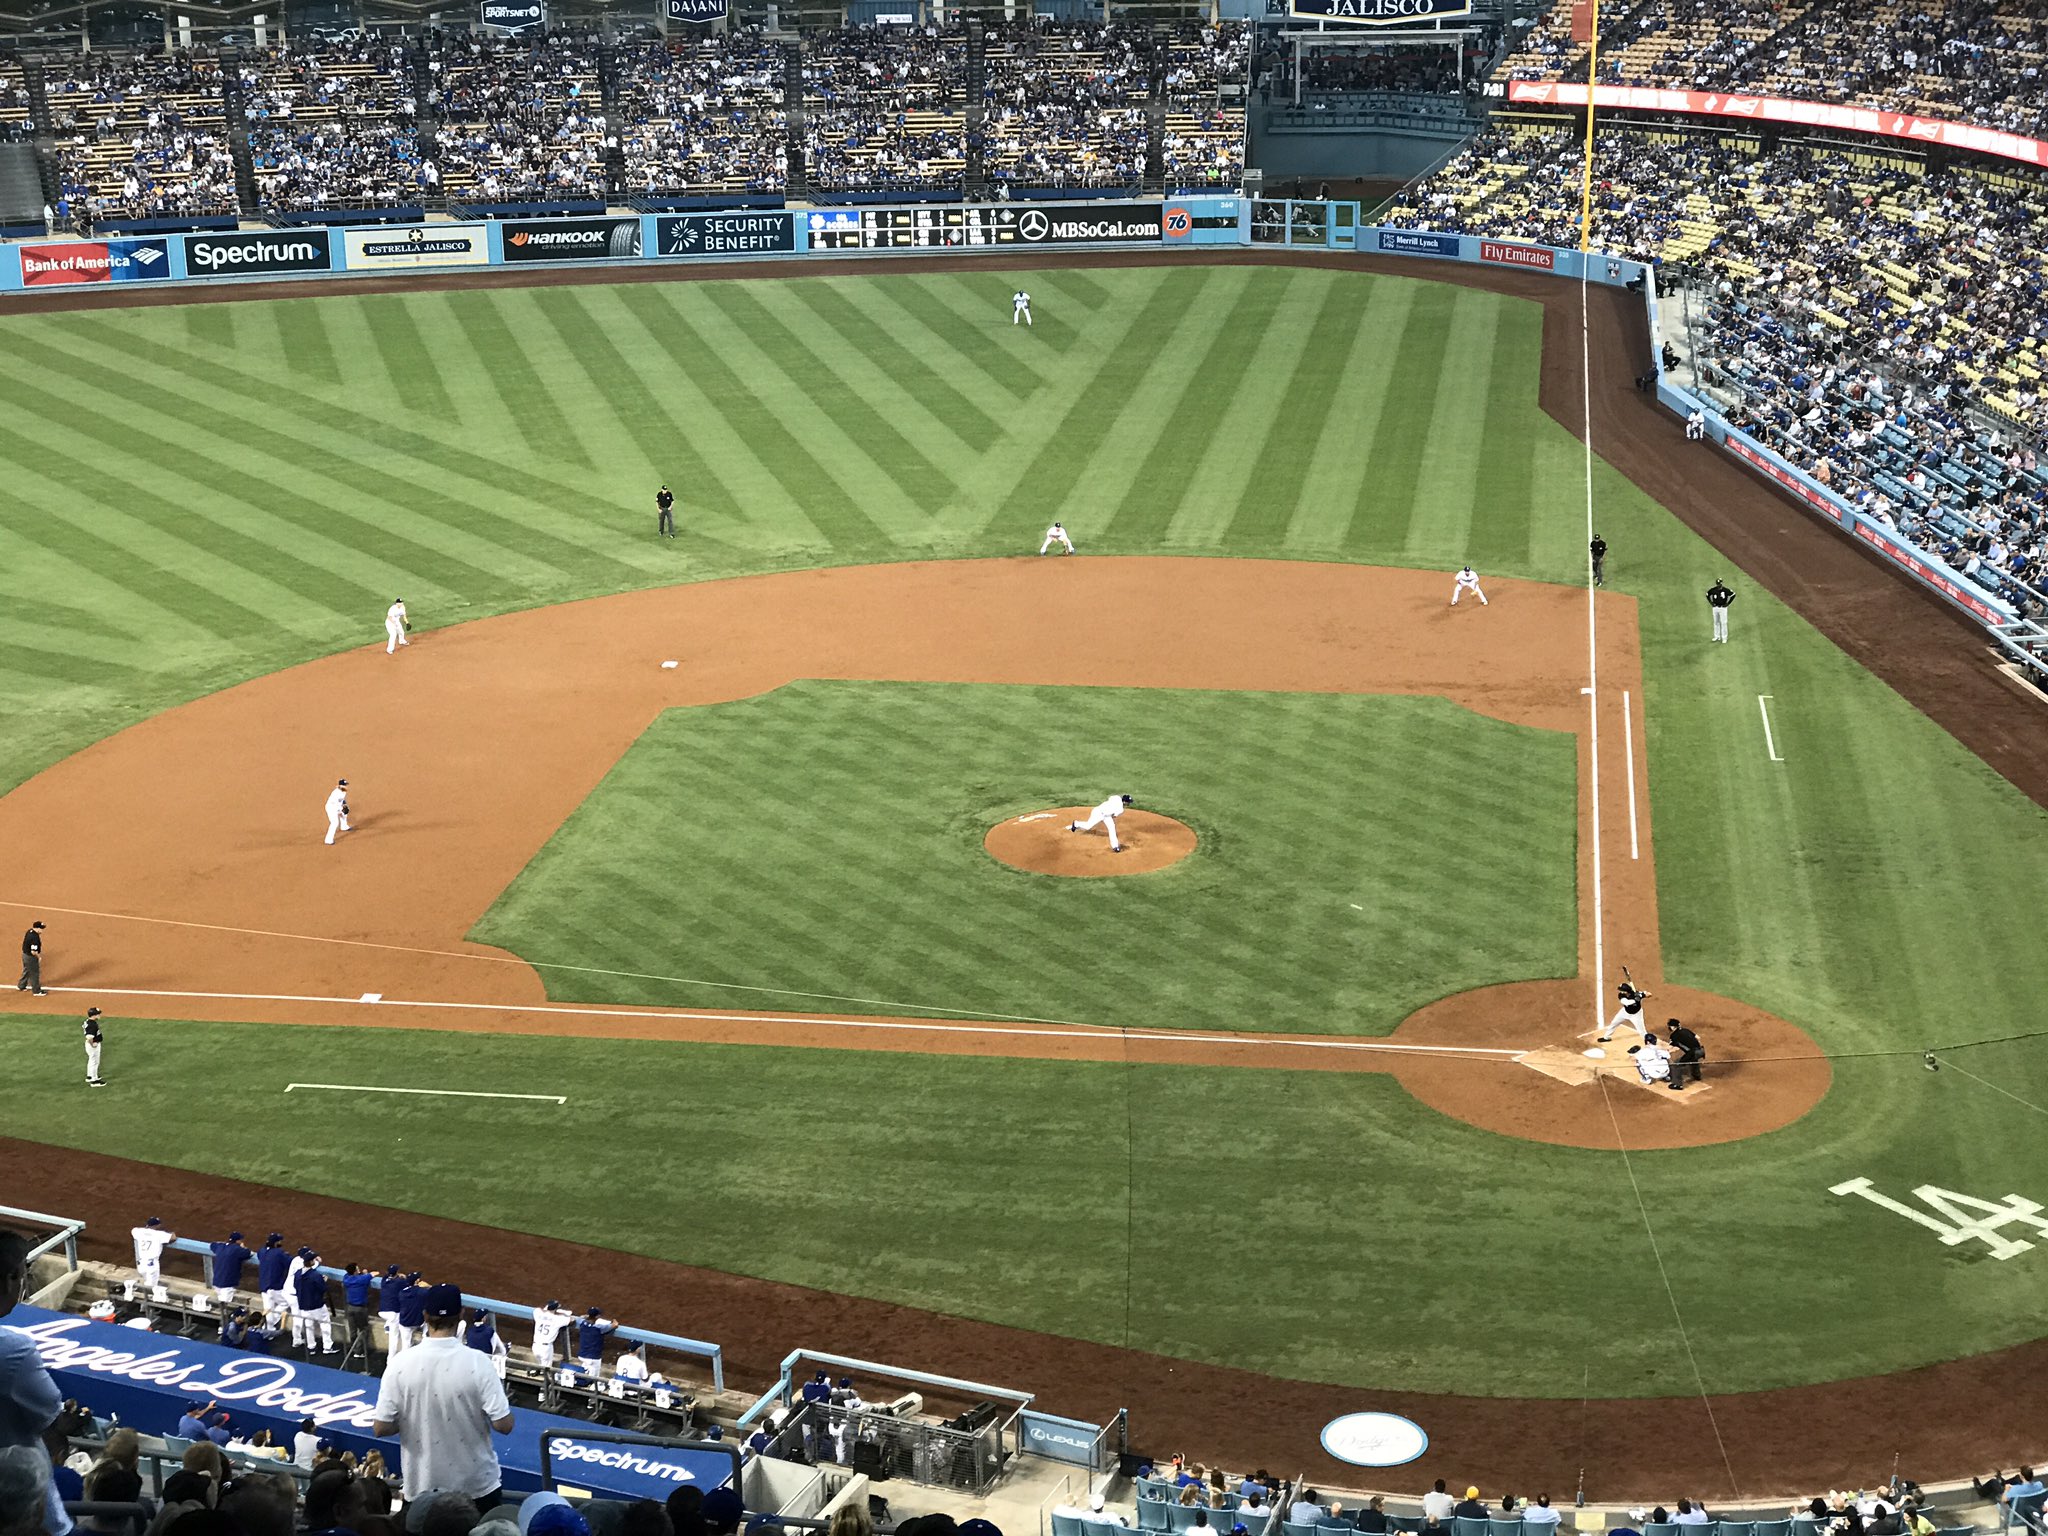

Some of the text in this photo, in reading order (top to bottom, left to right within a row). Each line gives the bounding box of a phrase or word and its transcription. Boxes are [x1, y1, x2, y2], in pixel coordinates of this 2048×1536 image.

[485, 9, 529, 18] SPORTSNET
[671, 0, 722, 15] DASANI
[1326, 0, 1433, 16] JALISCO
[704, 217, 784, 233] SECURITY
[1051, 220, 1160, 238] MBSoCal.com
[1166, 213, 1188, 231] 76
[369, 242, 465, 254] ESTRELLA JALISCO
[1396, 235, 1439, 247] Merrill Lynch
[24, 254, 131, 272] Bank of America
[194, 241, 313, 270] Spectrum
[1485, 244, 1551, 266] Fly Emirates
[538, 1323, 551, 1335] 45
[180, 1357, 378, 1427] Dodge
[1046, 1433, 1089, 1449] LEXUS
[548, 1438, 686, 1482] Spectrum
